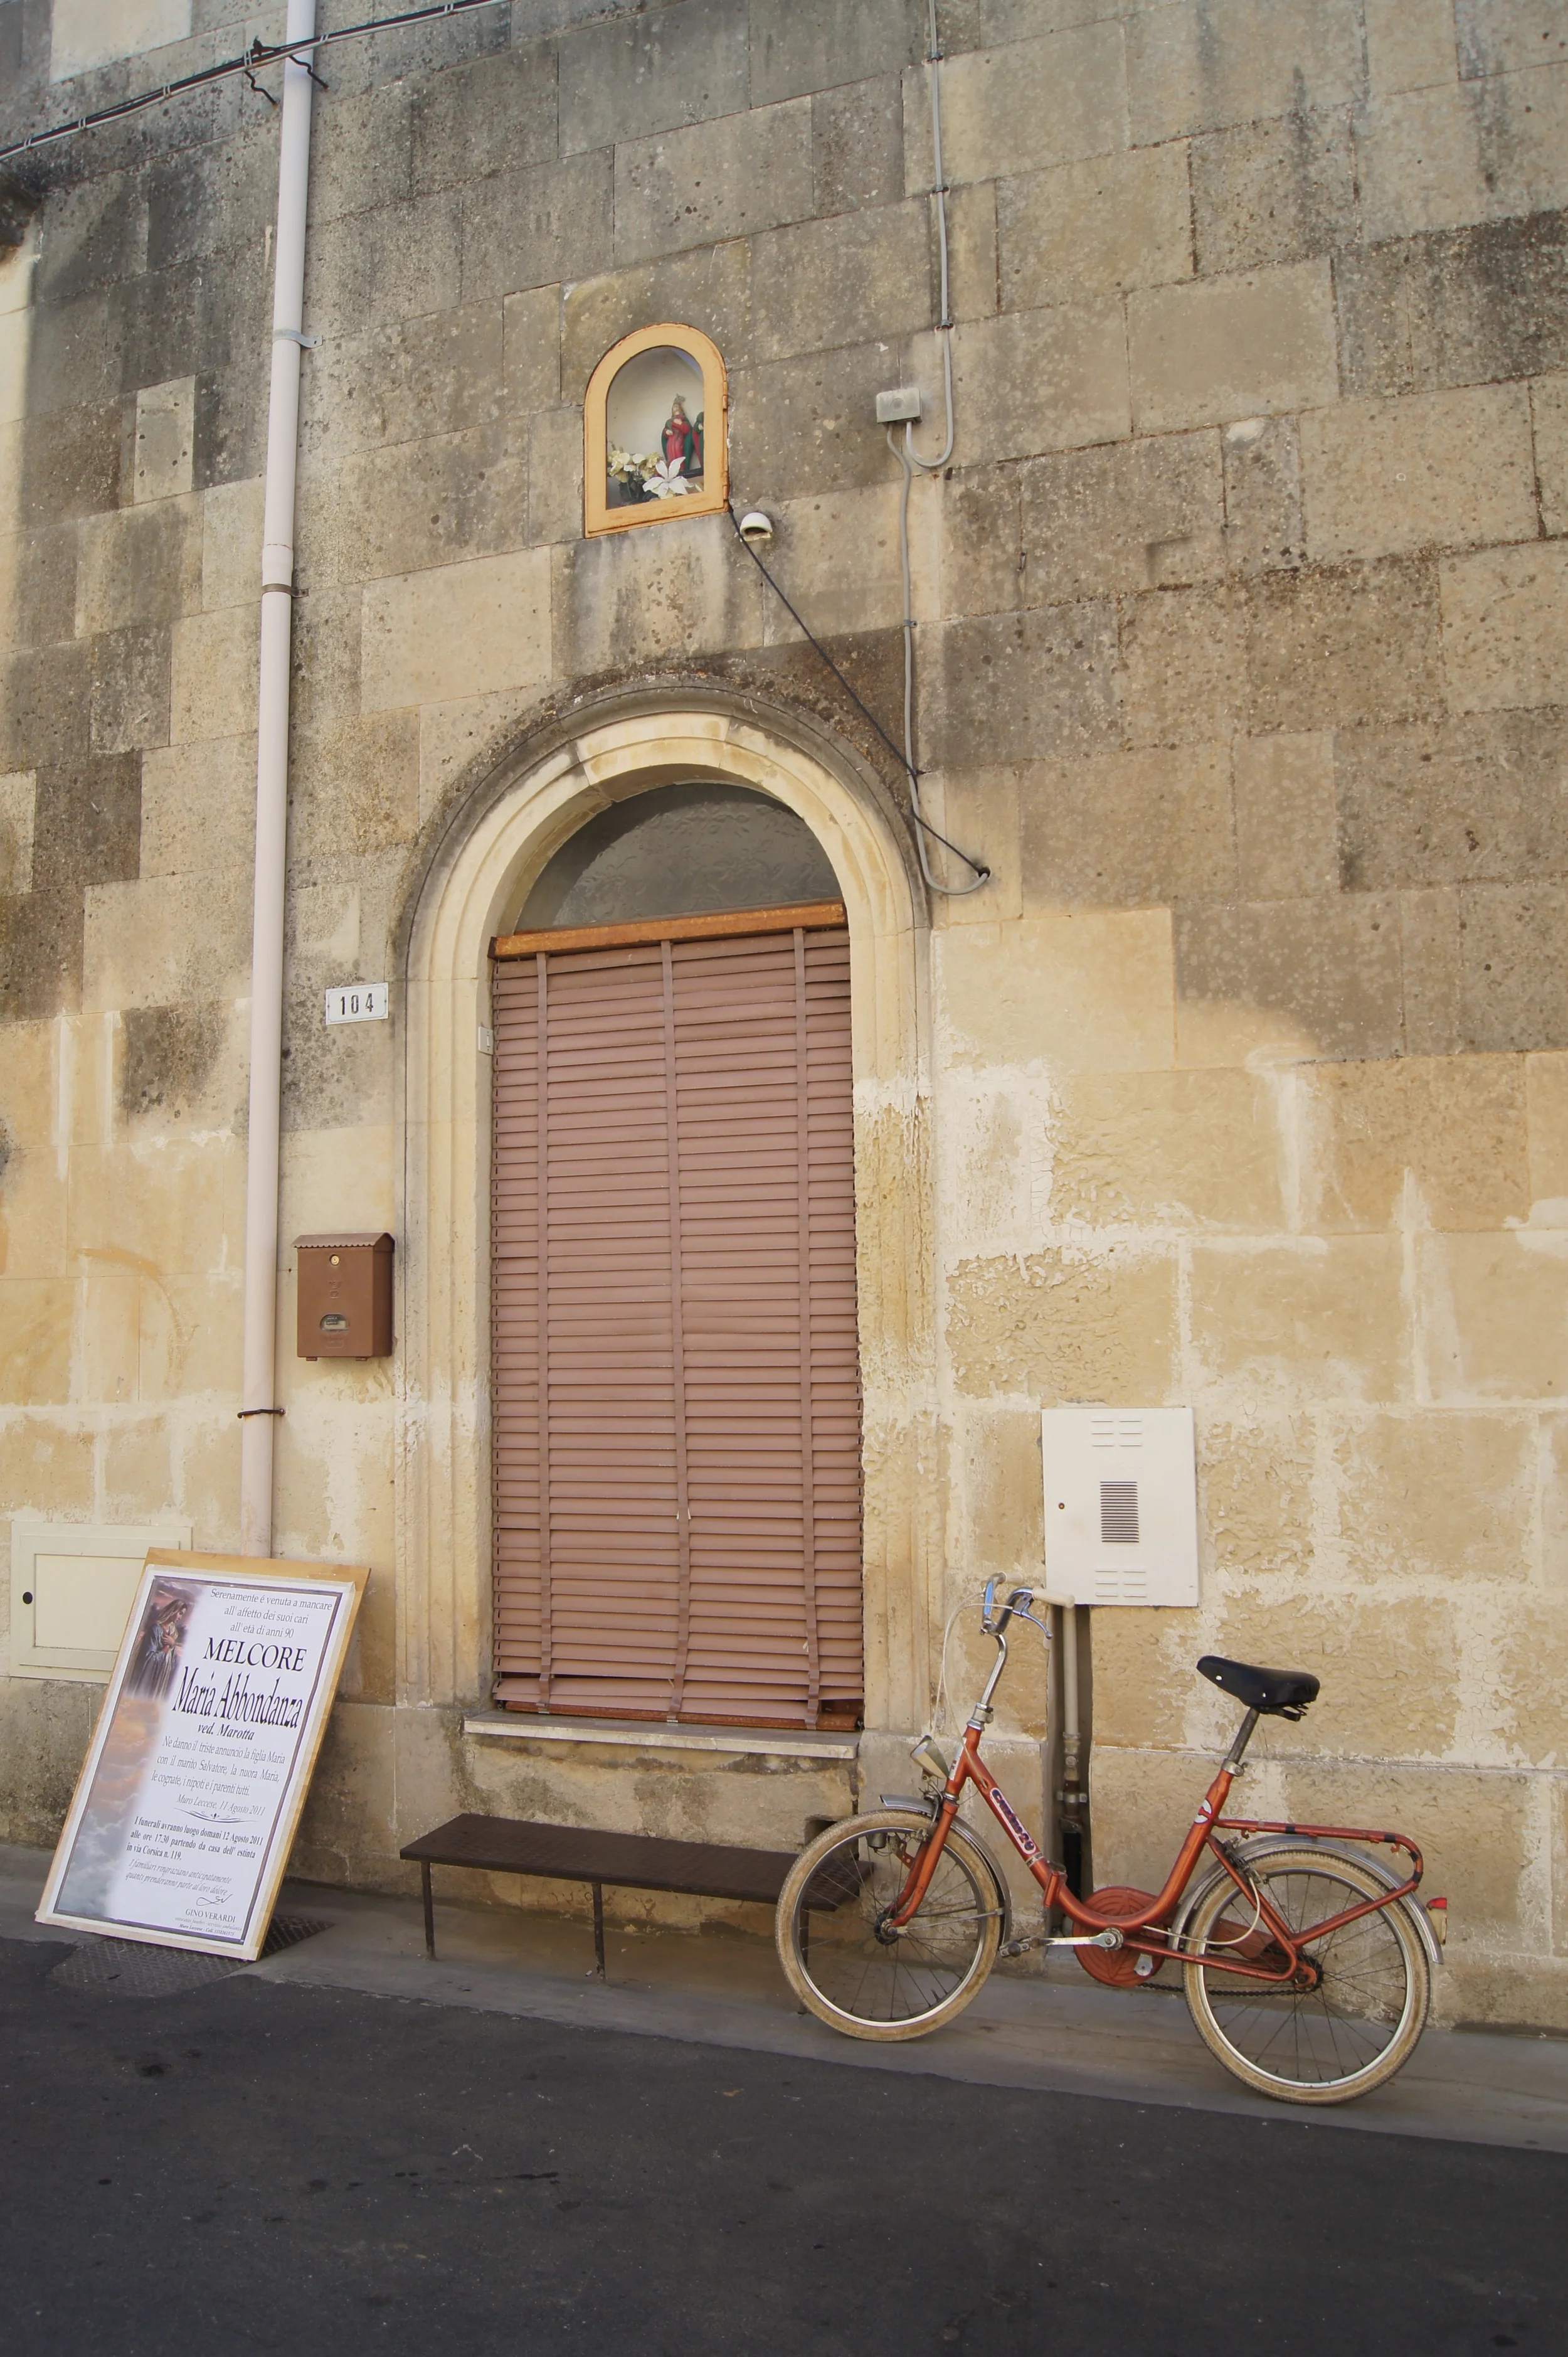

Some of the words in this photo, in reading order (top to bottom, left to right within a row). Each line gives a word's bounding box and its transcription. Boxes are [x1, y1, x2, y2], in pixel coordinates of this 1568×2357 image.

[340, 993, 373, 1015] 104
[211, 1588, 258, 1603] Serenamente
[260, 1595, 265, 1603] é
[267, 1597, 291, 1606] venuta
[299, 1601, 332, 1610] mancare
[224, 1605, 236, 1615] all'
[237, 1607, 262, 1619] affetto
[263, 1610, 275, 1620] dei
[277, 1612, 293, 1622] suoi
[294, 1615, 309, 1624] cari
[230, 1622, 242, 1631] all'
[243, 1625, 255, 1634] età
[257, 1625, 265, 1635] di
[266, 1627, 283, 1637] anni
[285, 1629, 294, 1638] 90
[203, 1637, 307, 1672] MELCORE
[172, 1666, 216, 1716] Maria
[214, 1671, 303, 1728] Abbondanza
[198, 1722, 215, 1735] ved.
[217, 1724, 255, 1740] Marotta
[162, 1736, 172, 1747] Ne
[173, 1737, 191, 1750] danno
[192, 1740, 197, 1751] il
[199, 1742, 215, 1753] triste
[215, 1746, 243, 1757] annuncio
[245, 1747, 250, 1759] la
[250, 1748, 268, 1764] figlia
[267, 1751, 285, 1764] Maria
[157, 1756, 169, 1764] con
[170, 1755, 176, 1766] il
[177, 1758, 197, 1769] marito
[199, 1759, 228, 1775] Salvatore,
[231, 1764, 236, 1775] la
[240, 1769, 258, 1779] nuora
[260, 1769, 280, 1784] Maria,
[151, 1770, 157, 1781] le
[158, 1774, 181, 1787] cognate,
[188, 1777, 206, 1791] nipoti
[212, 1782, 237, 1794] parenti
[236, 1785, 250, 1796] tutti.
[176, 1794, 193, 1804] Muro
[193, 1797, 217, 1809] Leccese,
[220, 1801, 228, 1811] 11
[228, 1803, 248, 1814] Agosto
[249, 1806, 265, 1816] 2011
[134, 1816, 139, 1824] I
[139, 1817, 161, 1829] funerali
[161, 1822, 184, 1833] avranno
[184, 1825, 199, 1837] luogo
[200, 1828, 223, 1839] domani
[222, 1831, 229, 1840] 12
[230, 1833, 249, 1844] Agosto
[250, 1836, 263, 1846] 2011
[126, 1843, 133, 1851] in
[143, 1845, 162, 1857] Corsica
[171, 1850, 182, 1860] 119.
[130, 1830, 141, 1839] alle
[170, 1838, 196, 1848] partendo
[199, 1841, 206, 1850] da
[208, 1844, 220, 1853] casa
[223, 1846, 236, 1855] dell'
[237, 1849, 256, 1858] estinta
[125, 1871, 144, 1880] quanti
[144, 1874, 177, 1887] prenderanno
[177, 1881, 192, 1890] parte
[198, 1883, 210, 1893] loro
[210, 1885, 228, 1895] dolore
[132, 1860, 157, 1871] familiari
[156, 1865, 188, 1878] ringraziano
[188, 1870, 231, 1884] anticipatamente
[186, 1908, 203, 1917] GINO
[204, 1911, 236, 1923] VERARDI
